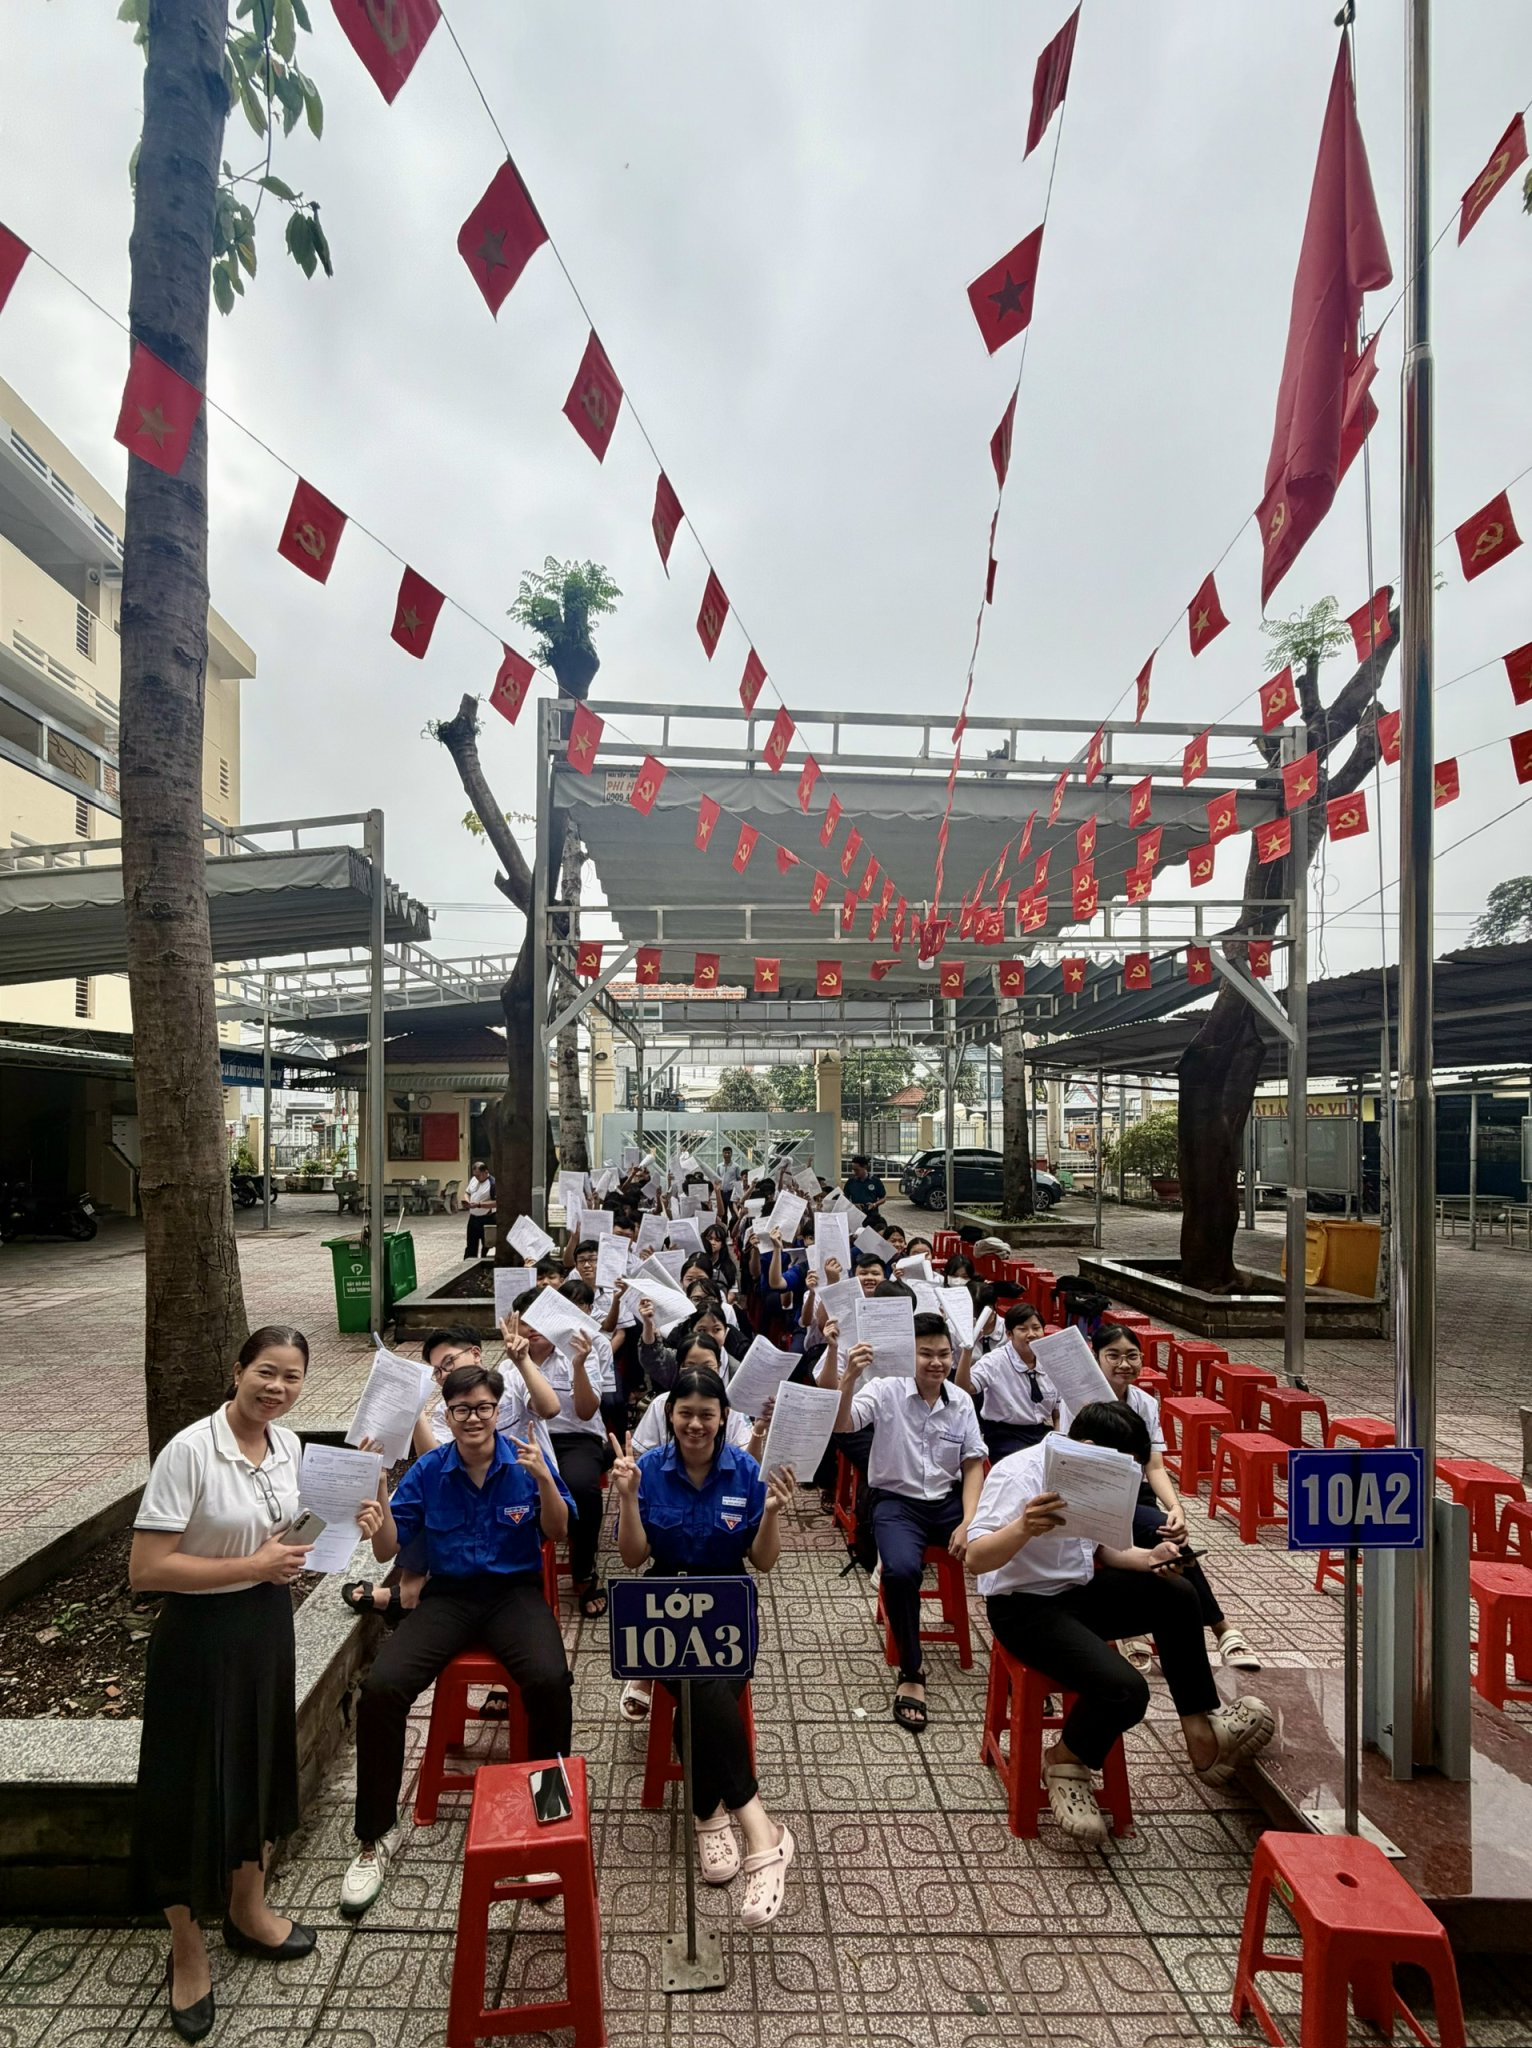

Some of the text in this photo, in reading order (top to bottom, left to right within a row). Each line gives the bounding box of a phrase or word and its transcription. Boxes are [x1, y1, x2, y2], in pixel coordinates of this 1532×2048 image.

[1301, 1472, 1411, 1526] 10A2
[646, 1588, 714, 1619] LỚP
[619, 1625, 744, 1669] 10A3
